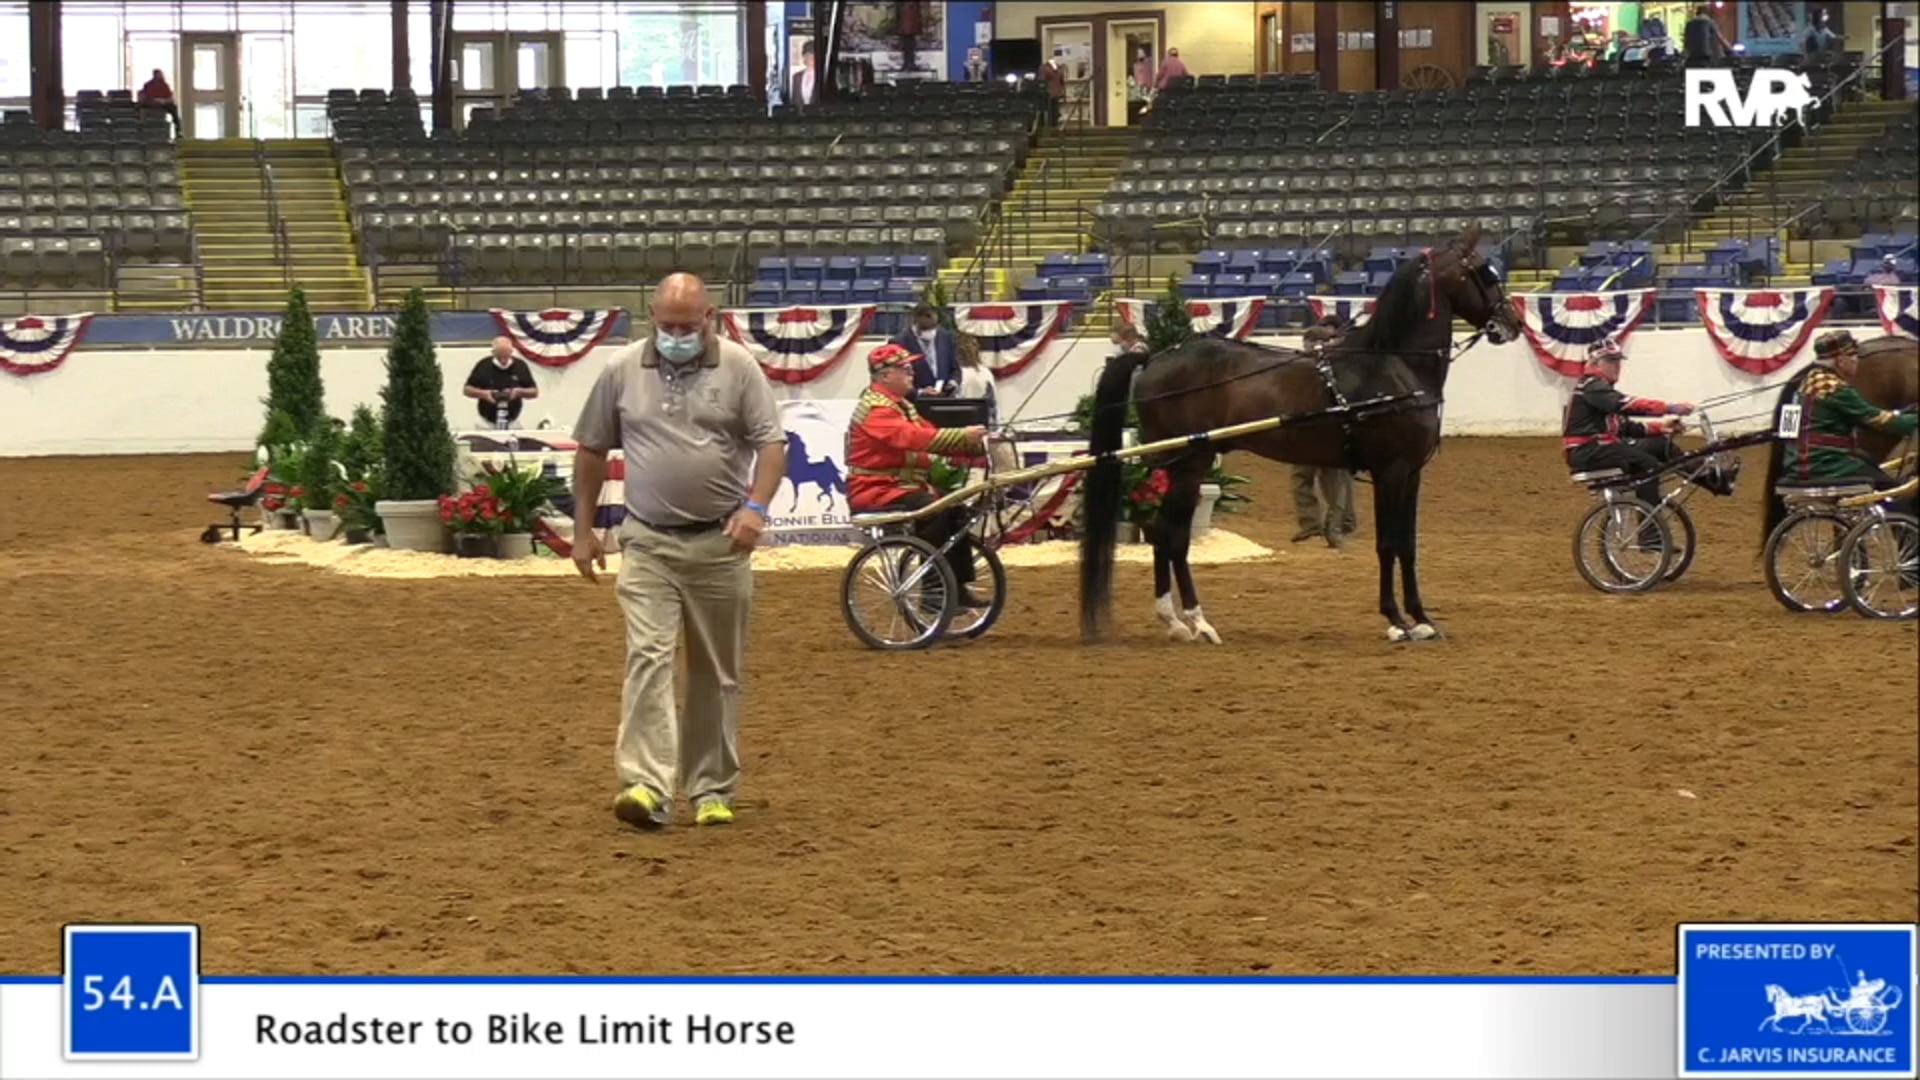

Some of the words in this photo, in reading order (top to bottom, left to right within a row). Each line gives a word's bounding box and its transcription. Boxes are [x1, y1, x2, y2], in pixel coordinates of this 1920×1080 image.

[170, 317, 319, 339] WALDR
[325, 317, 398, 338] AREN
[821, 513, 852, 525] BLU
